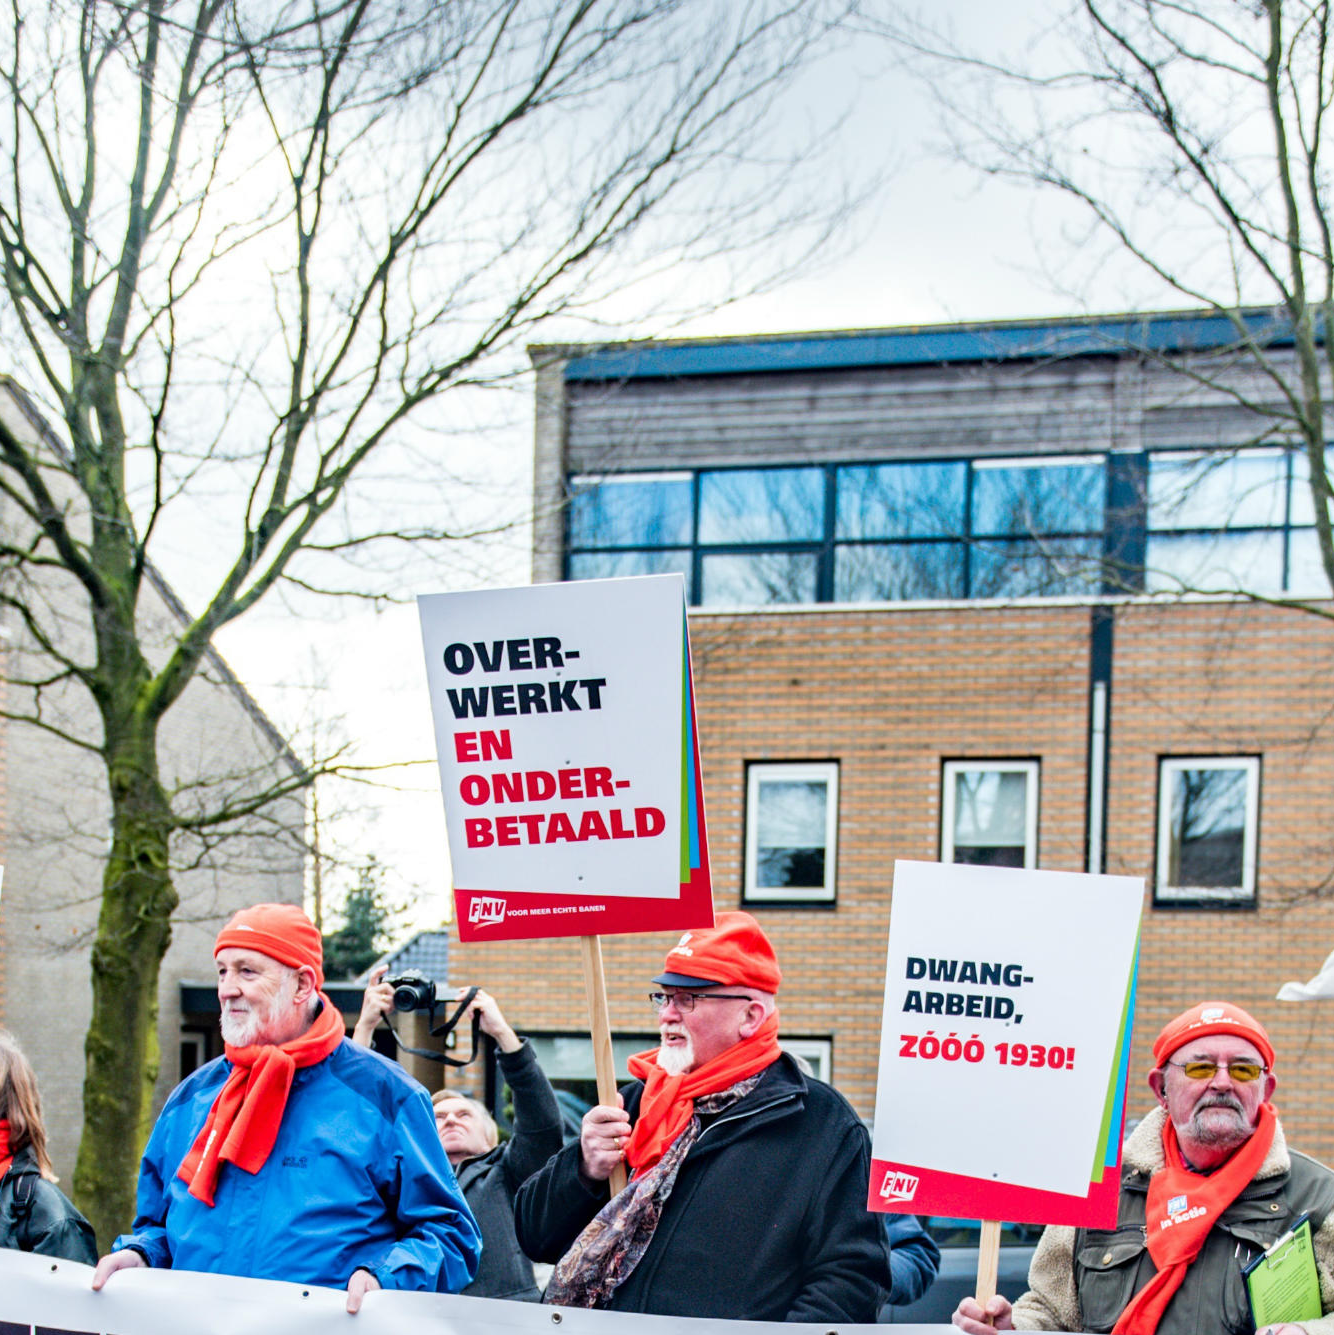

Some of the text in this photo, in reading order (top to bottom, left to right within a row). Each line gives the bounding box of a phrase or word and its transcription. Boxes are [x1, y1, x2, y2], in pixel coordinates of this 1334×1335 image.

[443, 636, 580, 675] OVER-
[446, 678, 607, 720] WERKT
[453, 729, 513, 763] EN
[459, 766, 631, 806] ONDER-
[464, 807, 666, 849] BETAALD
[470, 900, 505, 917] FNV
[507, 909, 528, 917] VOOR
[530, 907, 551, 916] MEER
[553, 906, 578, 914] ECHTE
[905, 956, 1034, 987] DWANG-
[902, 990, 1024, 1024] ARBEID,
[899, 1030, 1076, 1070] ZÓÓÓ 1930!
[883, 1175, 917, 1195] FNV
